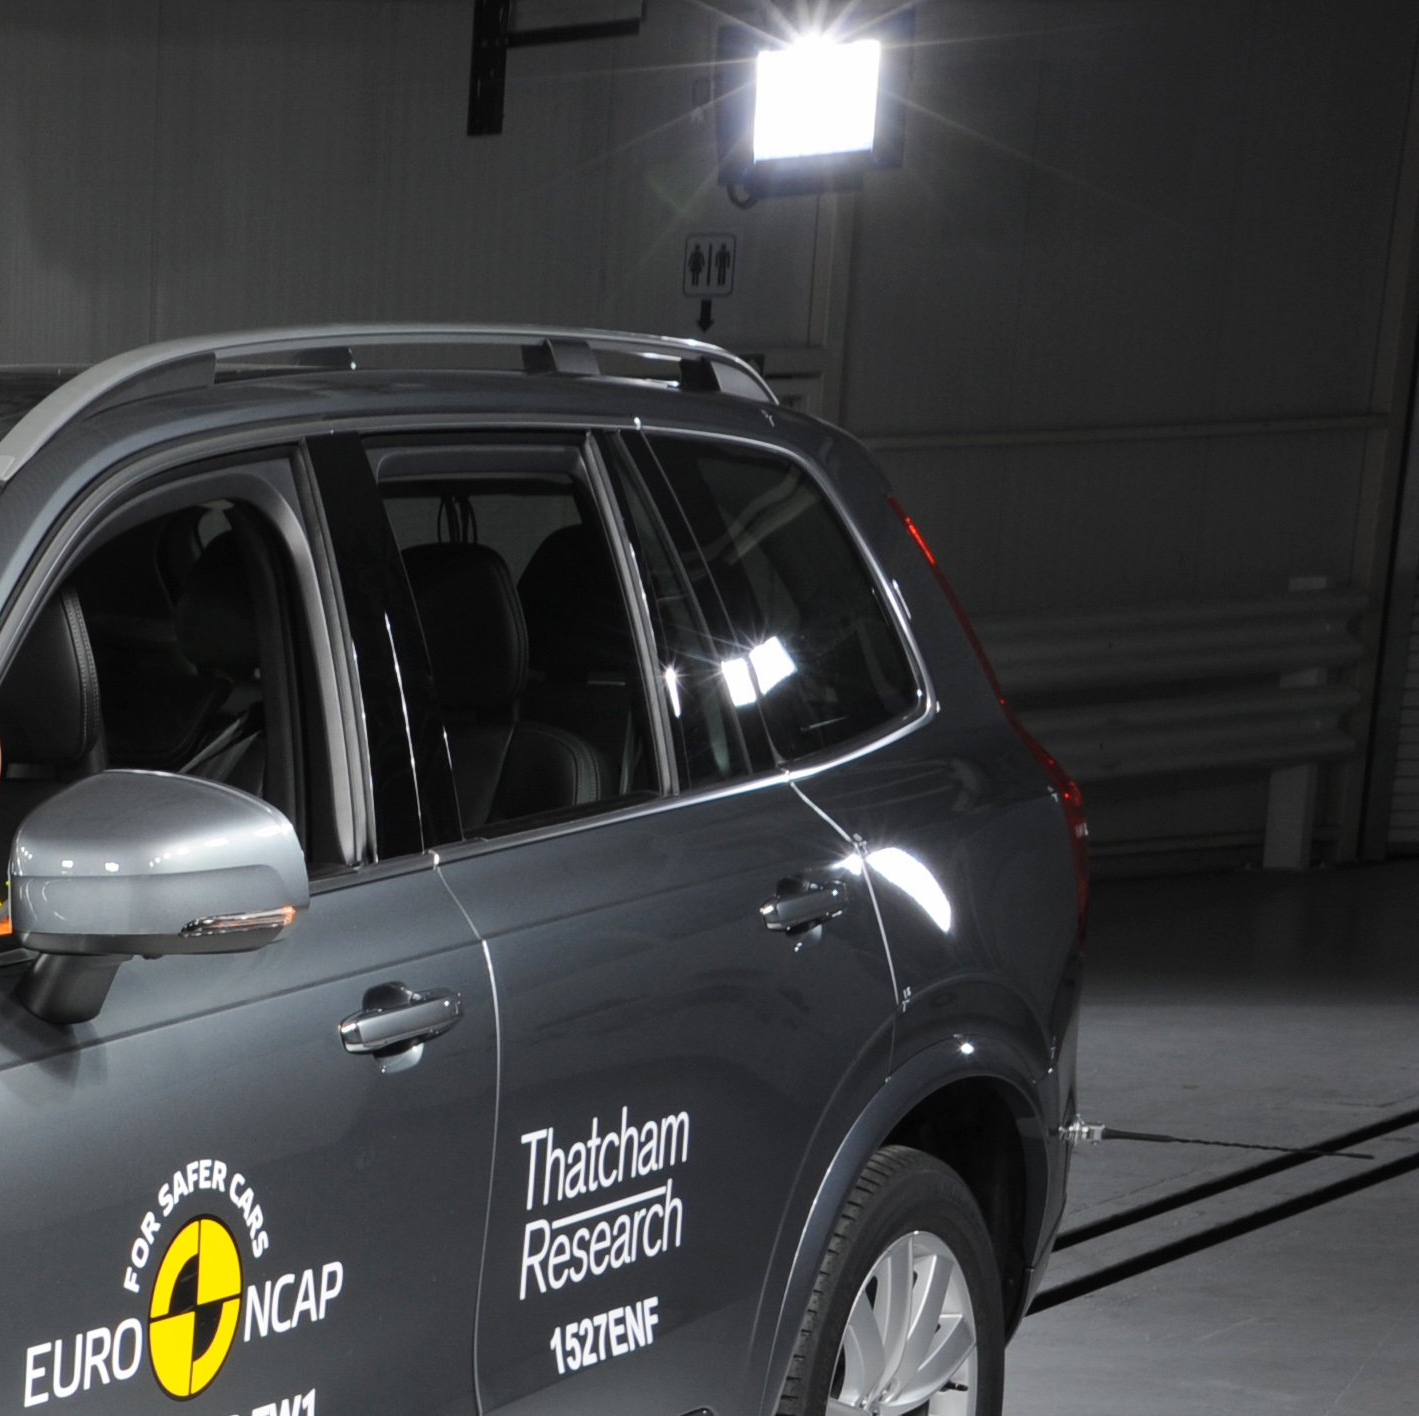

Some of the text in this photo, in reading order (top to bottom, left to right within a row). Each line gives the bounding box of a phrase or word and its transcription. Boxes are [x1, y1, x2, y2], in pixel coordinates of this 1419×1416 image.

[520, 1105, 690, 1211] Thatcham
[123, 1158, 270, 1293] FOR SAFER CARS
[519, 1177, 684, 1301] Research
[23, 1261, 344, 1408] EURO NCAP
[549, 1296, 660, 1375] 1527ENF
